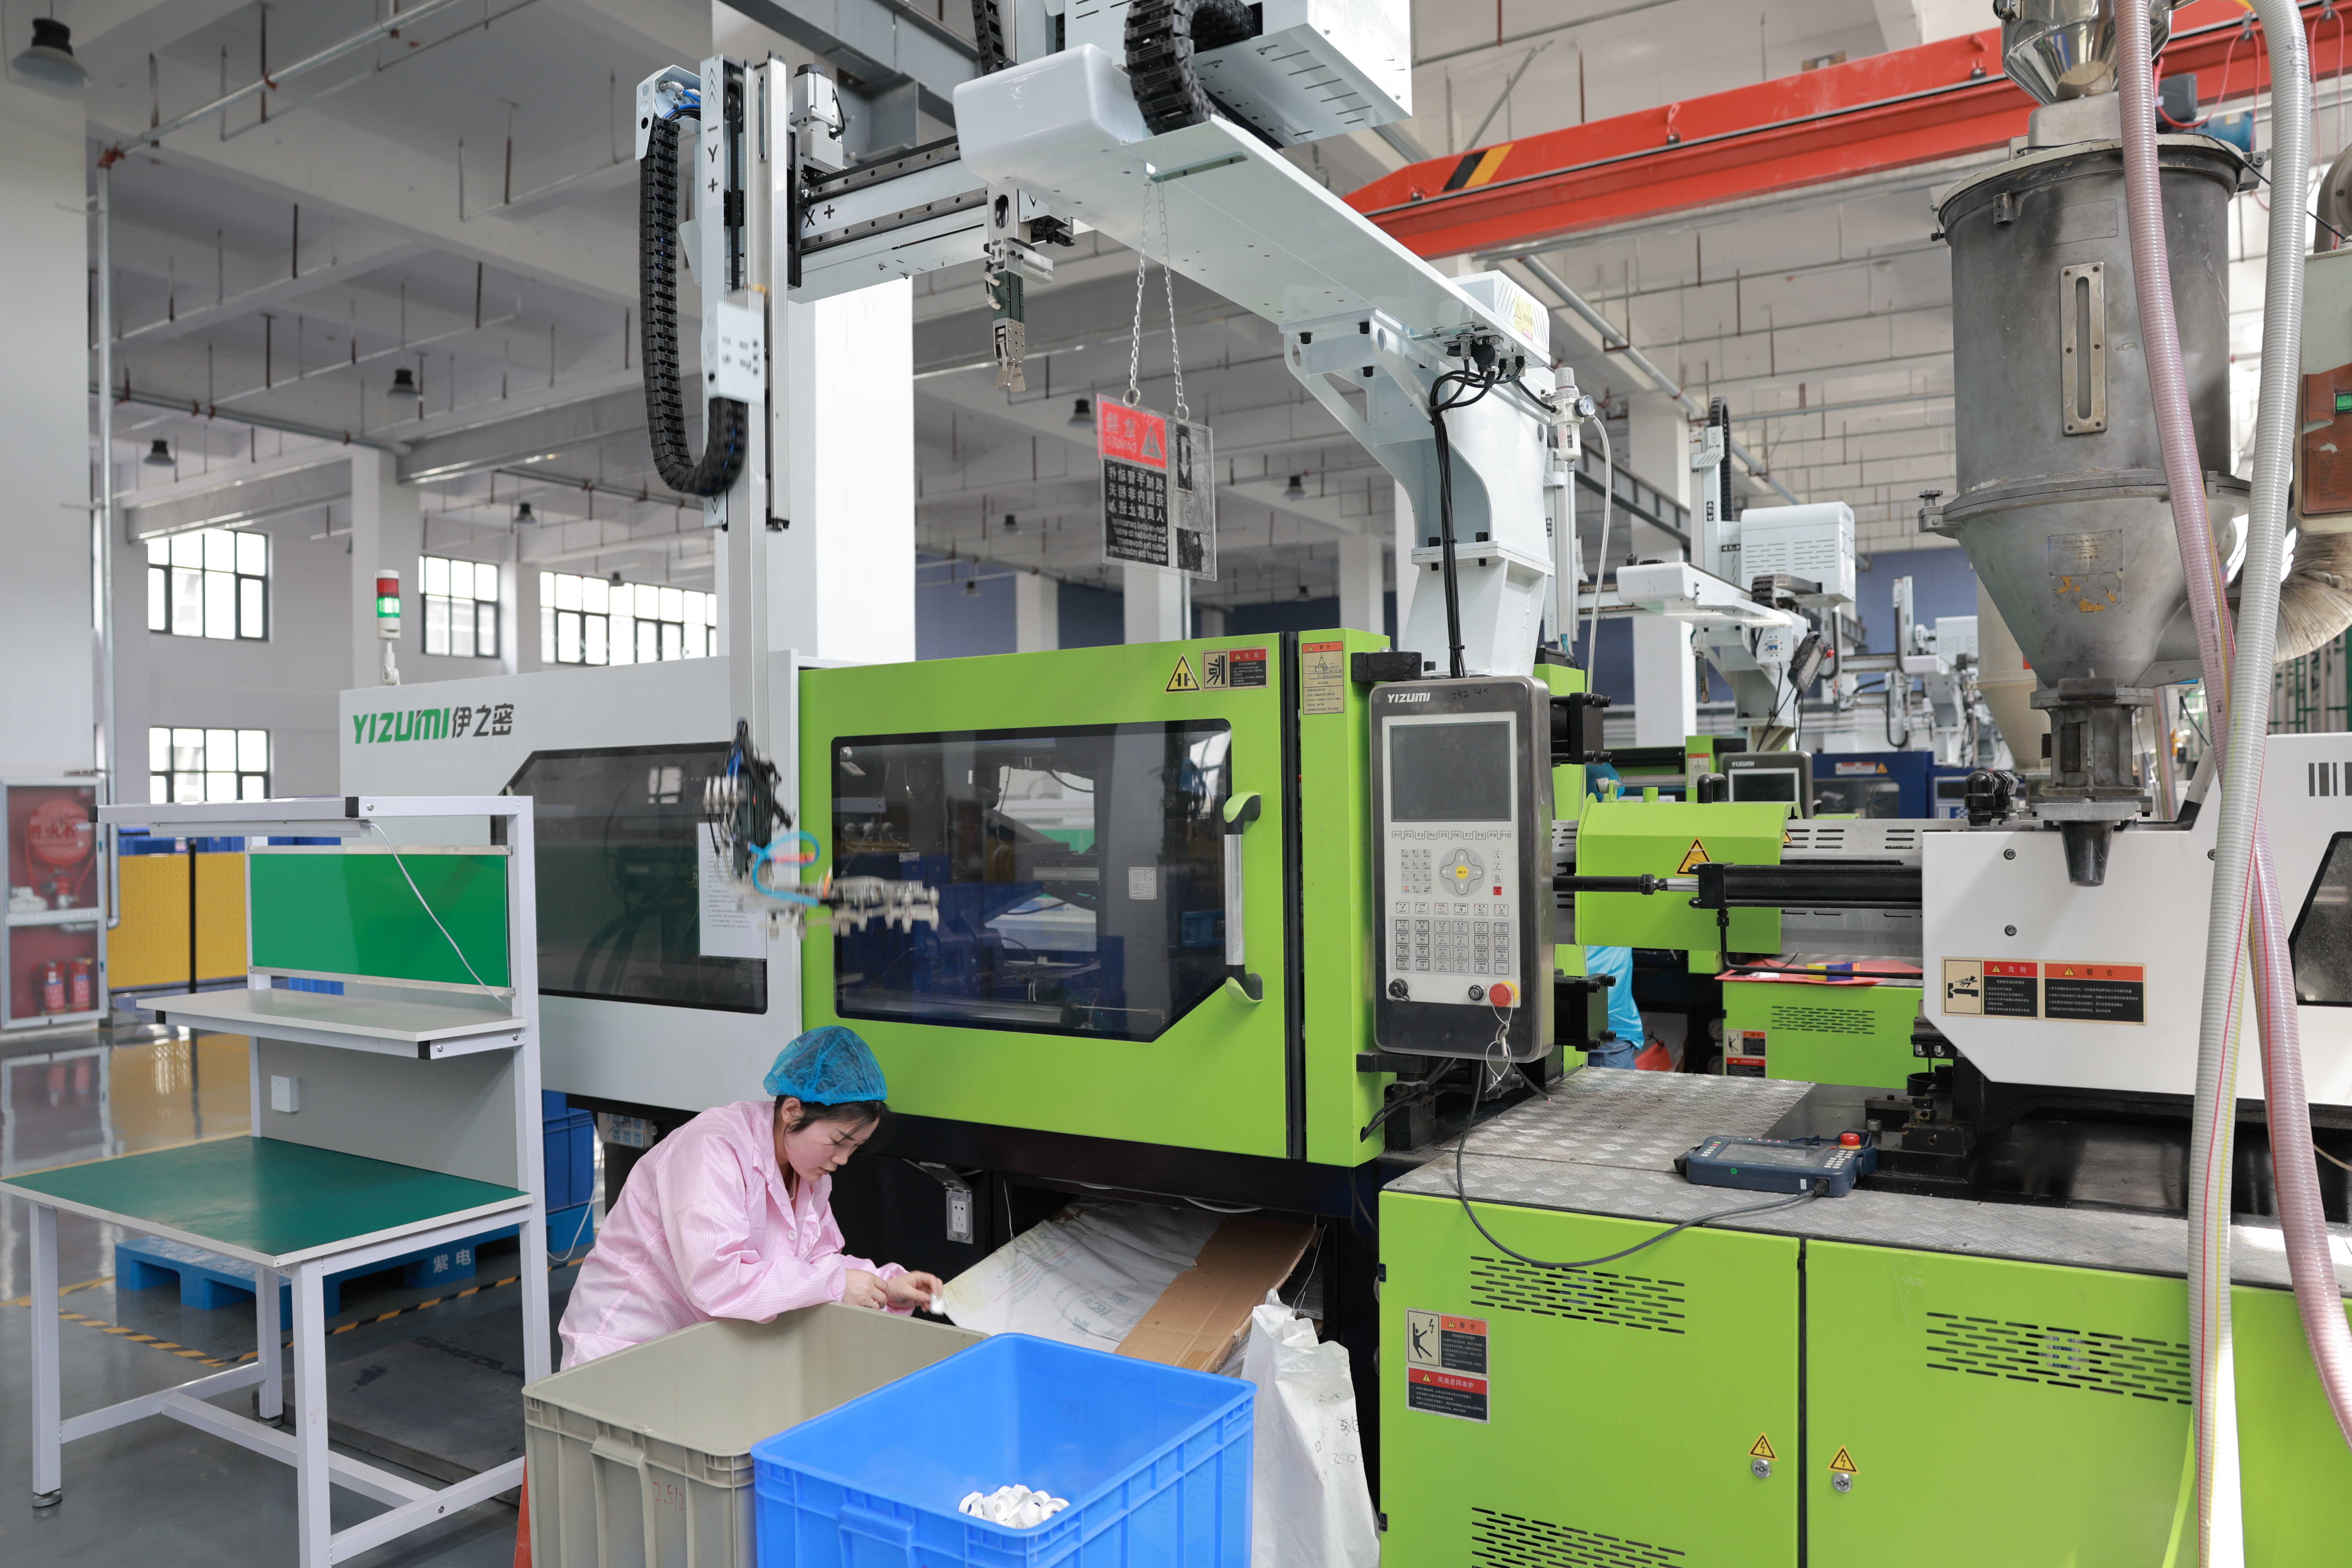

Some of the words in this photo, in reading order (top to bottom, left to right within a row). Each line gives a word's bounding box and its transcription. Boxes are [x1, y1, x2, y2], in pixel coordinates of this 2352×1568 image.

[804, 209, 815, 228] X
[1387, 692, 1430, 703] YIZUMI
[352, 707, 450, 744] YIZUMI
[451, 703, 514, 739] 伊之密
[2087, 968, 2113, 976] 警告
[433, 1249, 472, 1273] 紫电
[1460, 1321, 1475, 1330] 警告
[1437, 1376, 1474, 1388] 风扇滤网维护
